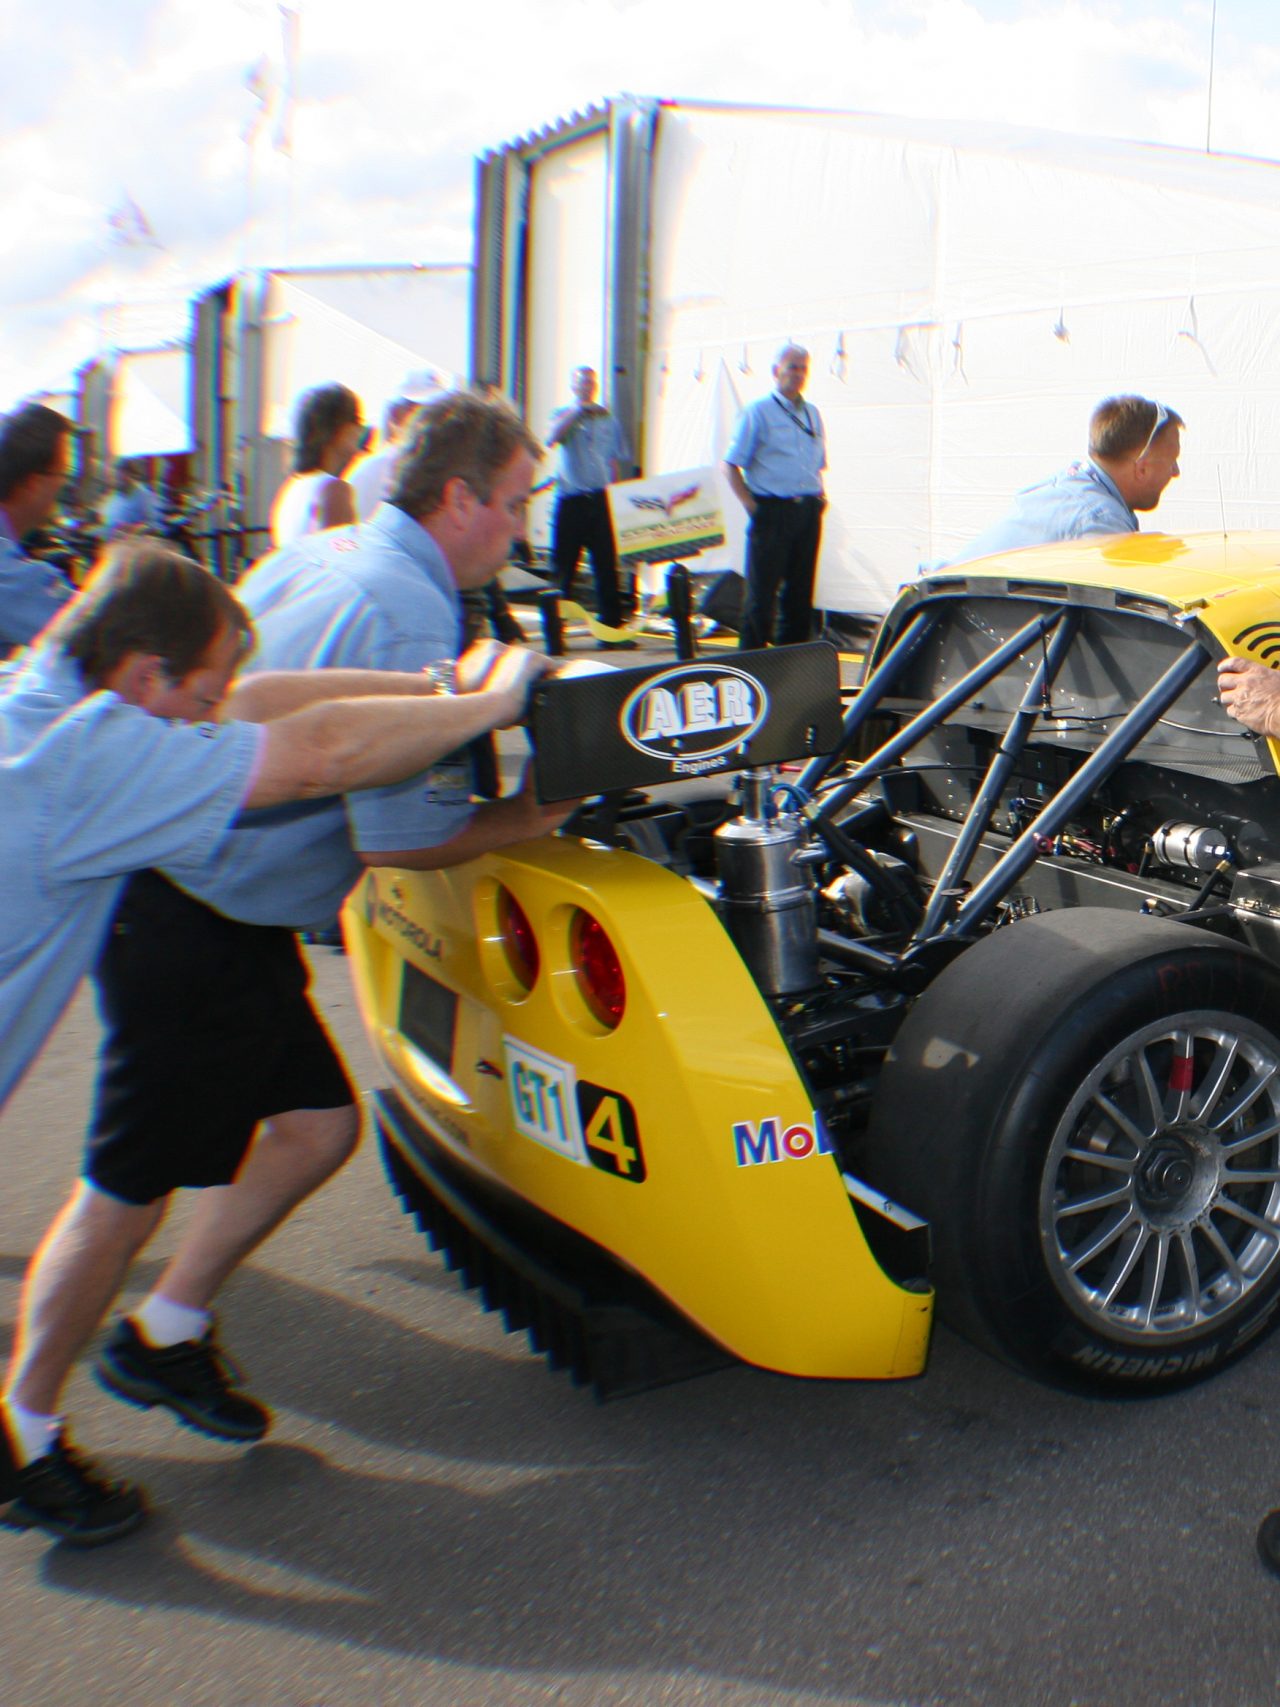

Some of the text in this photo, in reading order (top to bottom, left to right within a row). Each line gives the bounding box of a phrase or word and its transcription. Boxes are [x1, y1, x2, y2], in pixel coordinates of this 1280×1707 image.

[638, 676, 754, 741] AER
[672, 754, 726, 775] Engines
[512, 1061, 568, 1143] GT1
[585, 1095, 637, 1175] 4
[1072, 1345, 1219, 1377] MICHELIN
